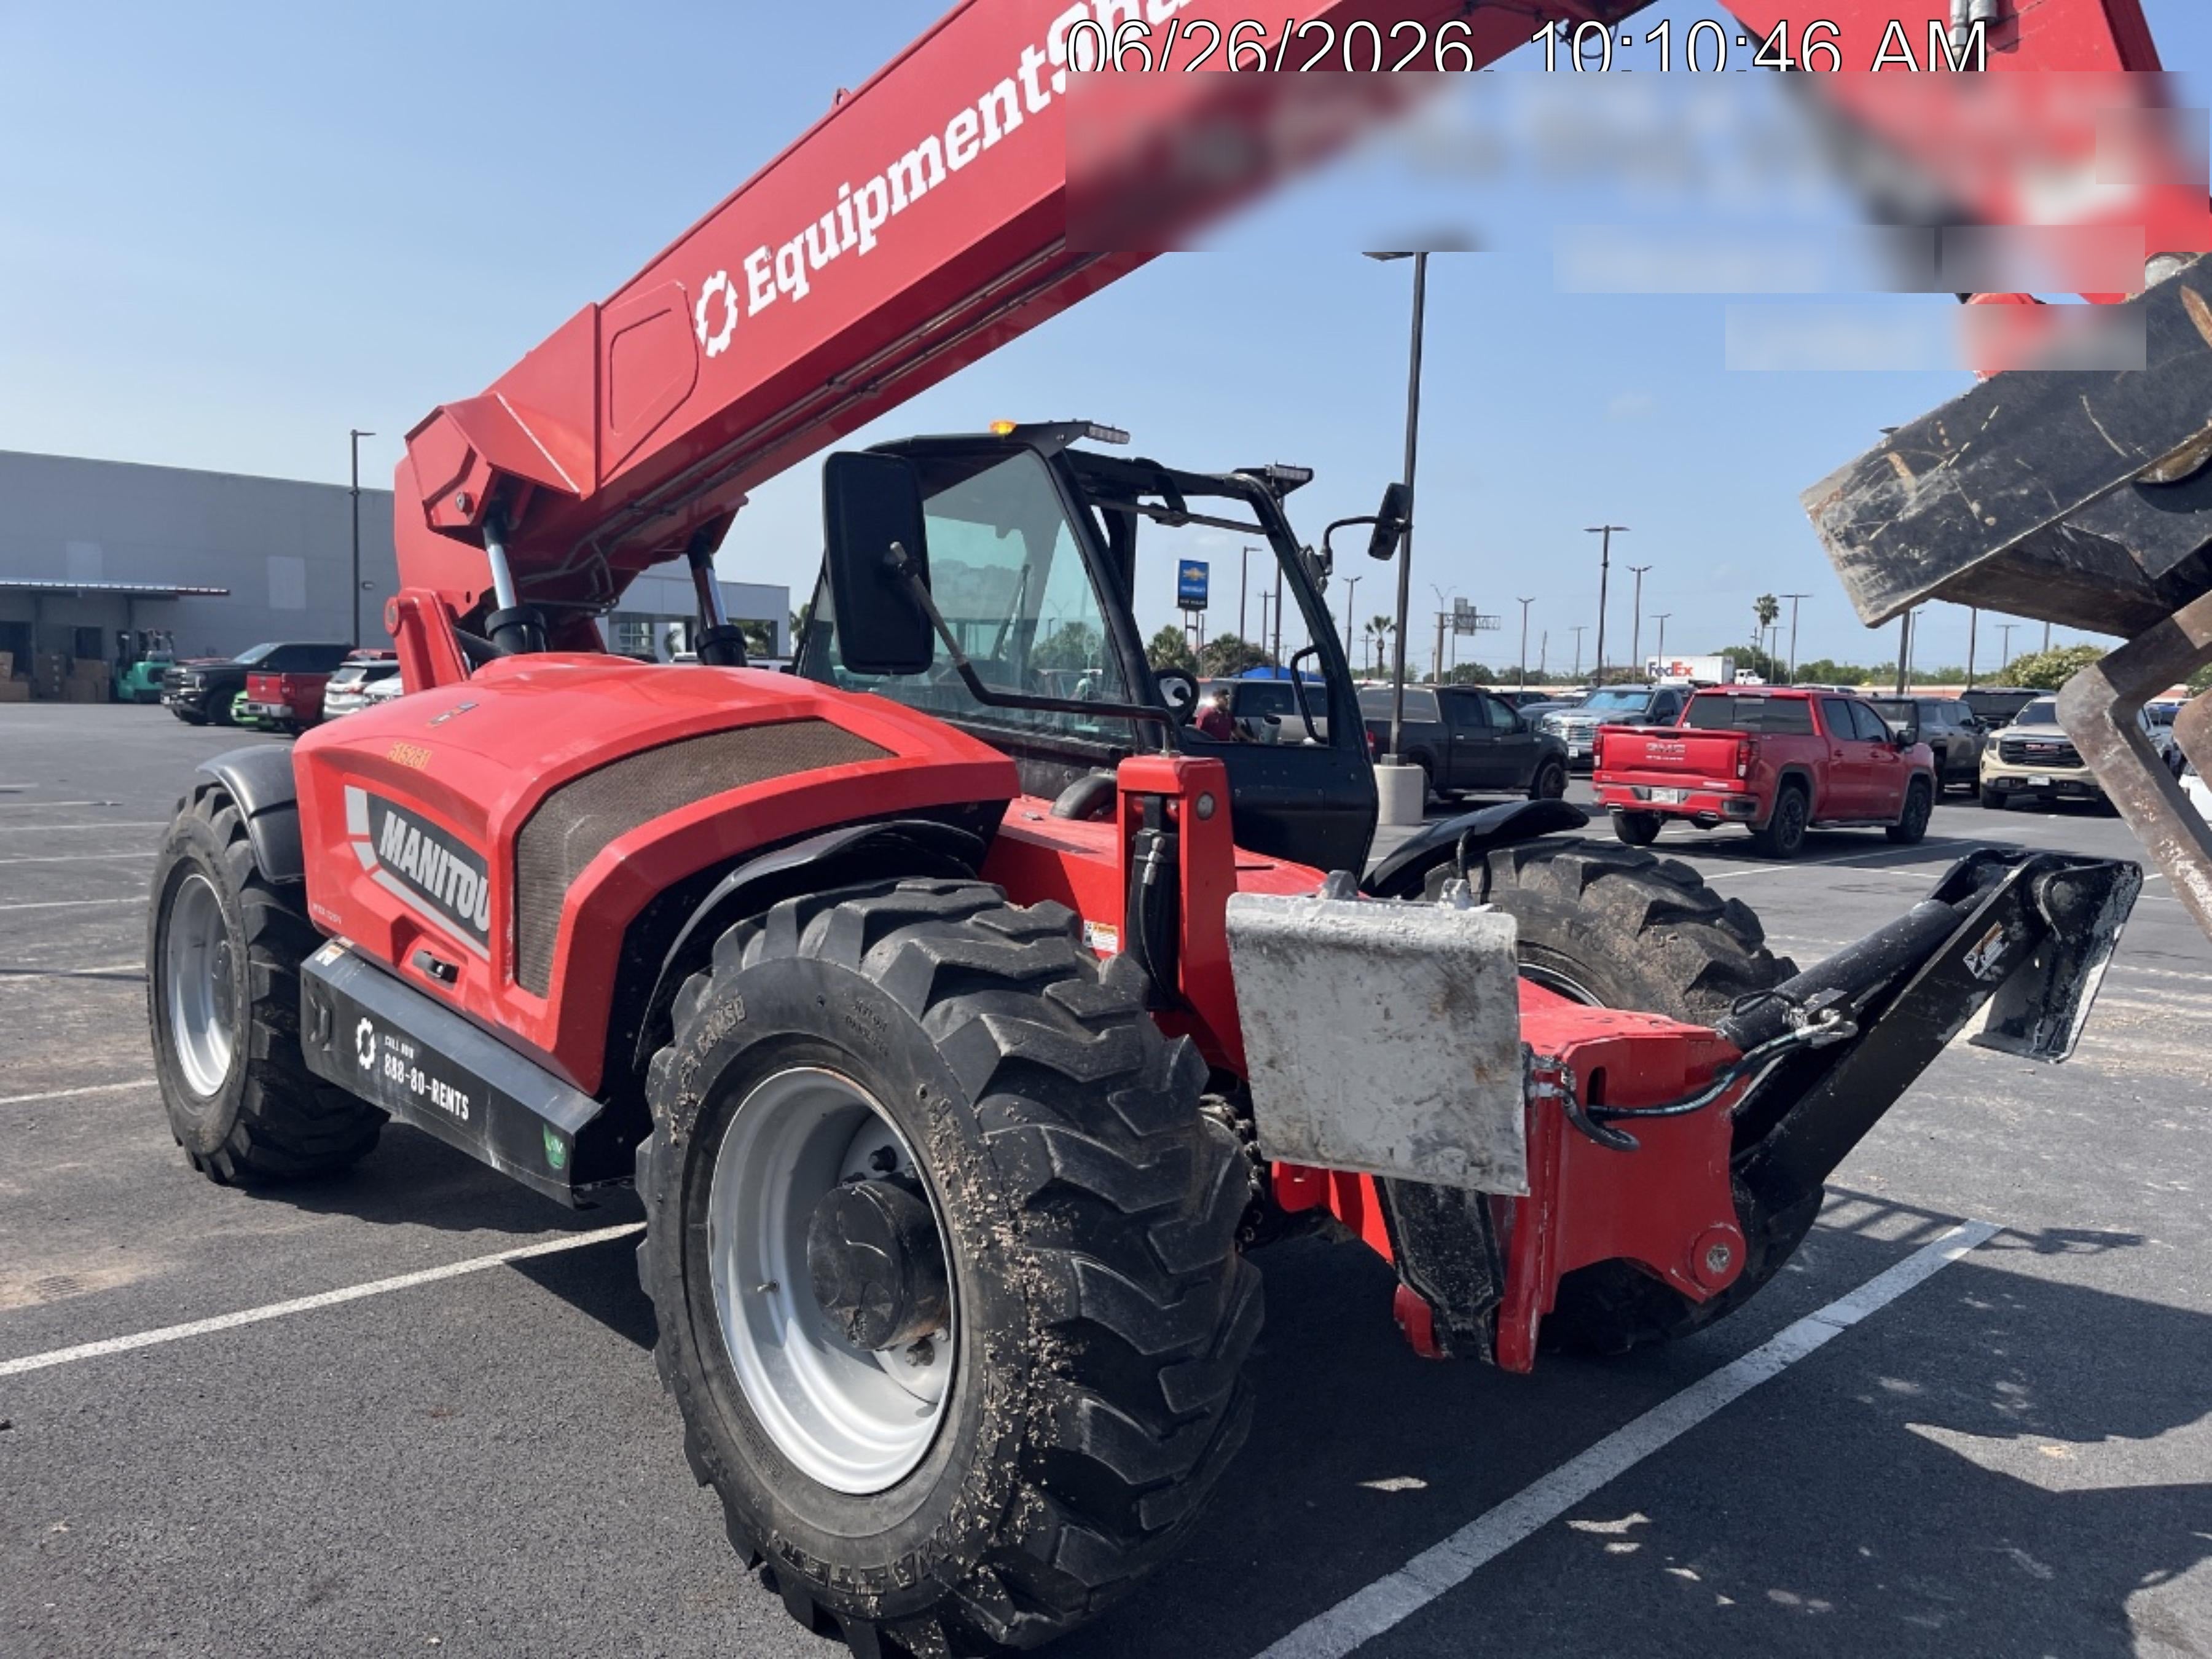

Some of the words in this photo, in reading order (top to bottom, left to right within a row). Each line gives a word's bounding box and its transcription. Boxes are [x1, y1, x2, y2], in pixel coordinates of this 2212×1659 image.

[744, 0, 1193, 317] EquipmentSh
[1648, 661, 1693, 677] FedEx
[379, 810, 490, 931] MANITOU
[385, 1052, 469, 1121] 888-80-RENTS
